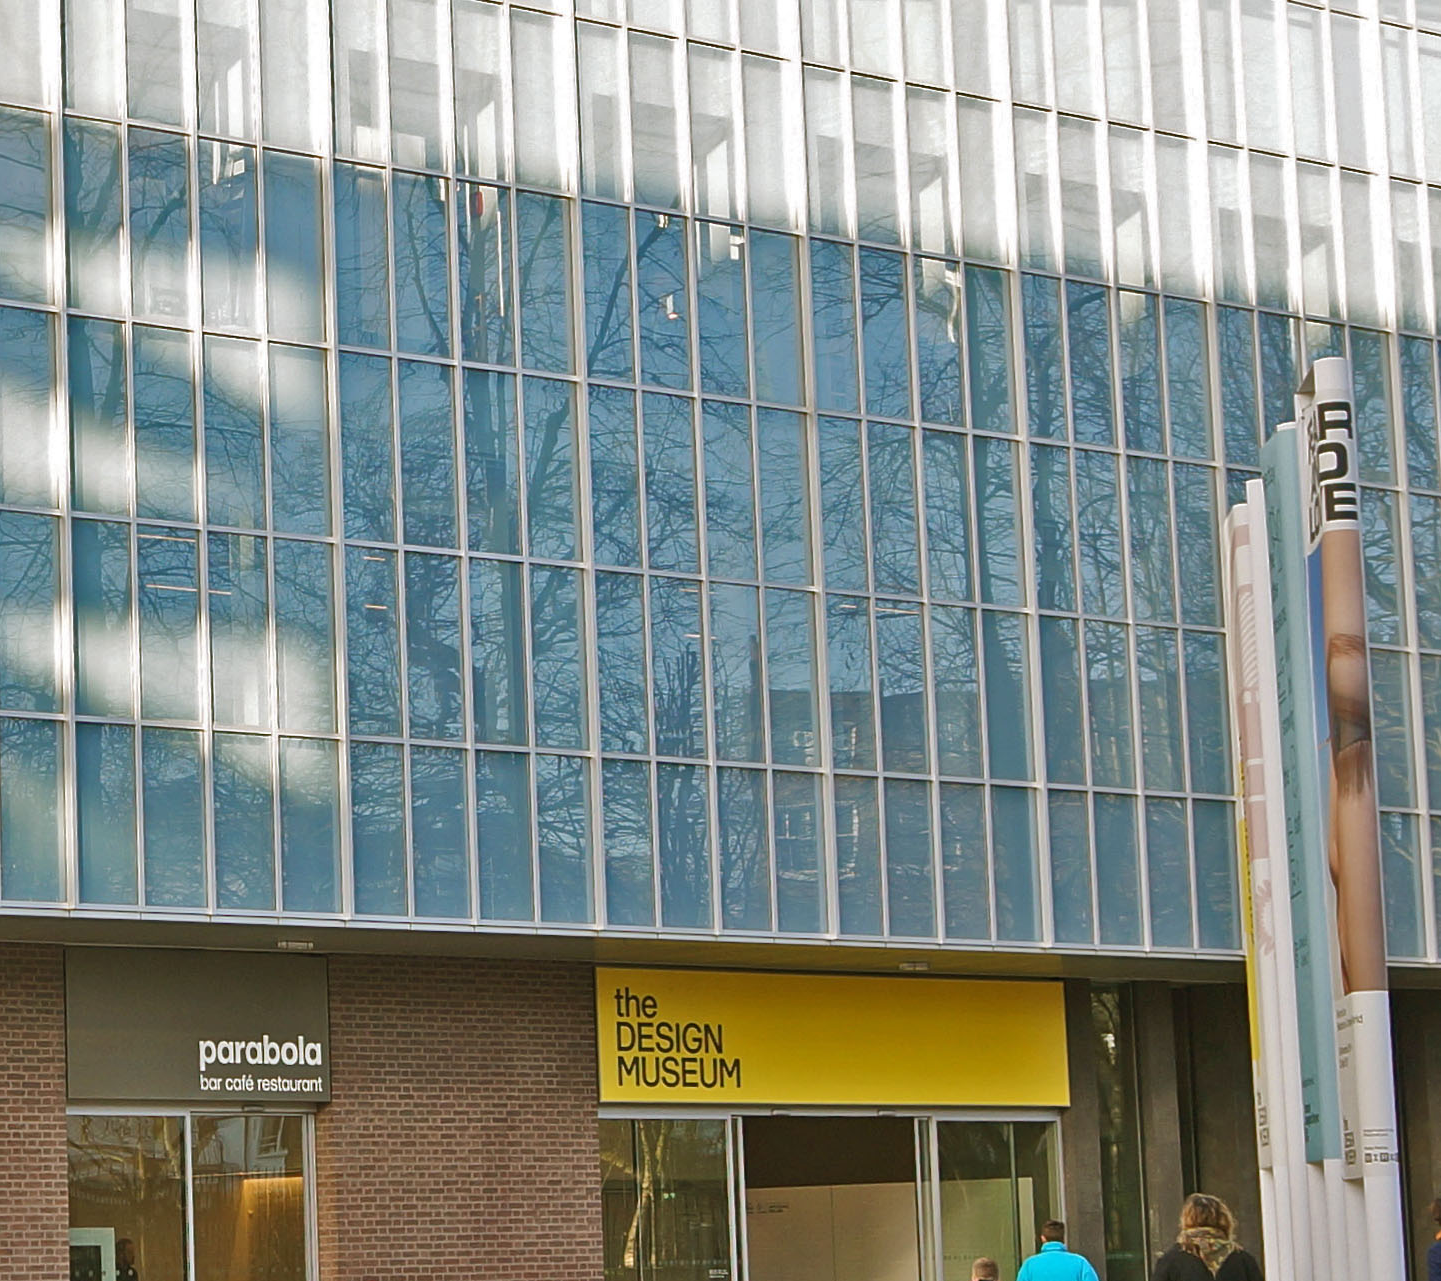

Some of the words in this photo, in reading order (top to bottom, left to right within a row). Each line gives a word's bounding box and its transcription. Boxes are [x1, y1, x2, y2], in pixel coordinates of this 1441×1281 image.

[614, 987, 658, 1018] the
[199, 1035, 322, 1071] parabola
[616, 1021, 723, 1054] DESIGN
[200, 1074, 223, 1091] bar
[225, 1074, 254, 1091] café
[257, 1076, 323, 1092] restaurant
[618, 1056, 741, 1088] MUSEUM
